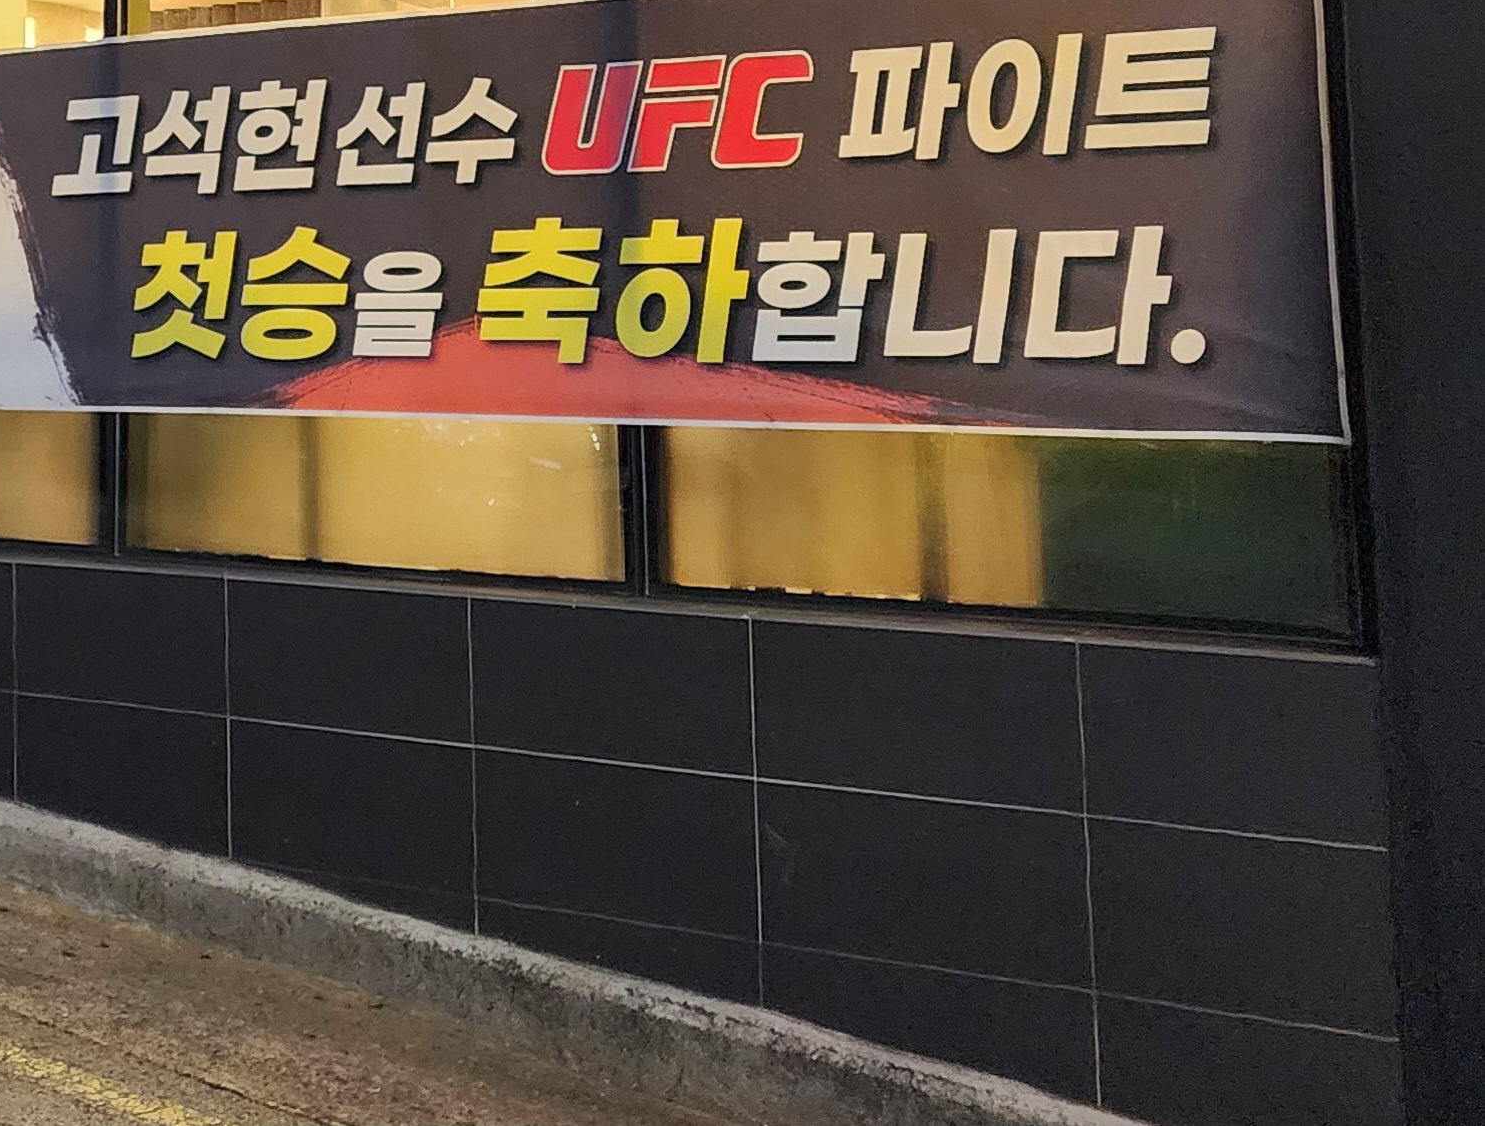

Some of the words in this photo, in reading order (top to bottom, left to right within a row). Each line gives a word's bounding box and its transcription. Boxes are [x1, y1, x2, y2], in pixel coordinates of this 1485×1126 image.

[540, 49, 814, 174] UFC
[838, 26, 1217, 160] 파이트
[131, 226, 443, 361] 첫승을
[478, 217, 1207, 365] 축하합니다.
